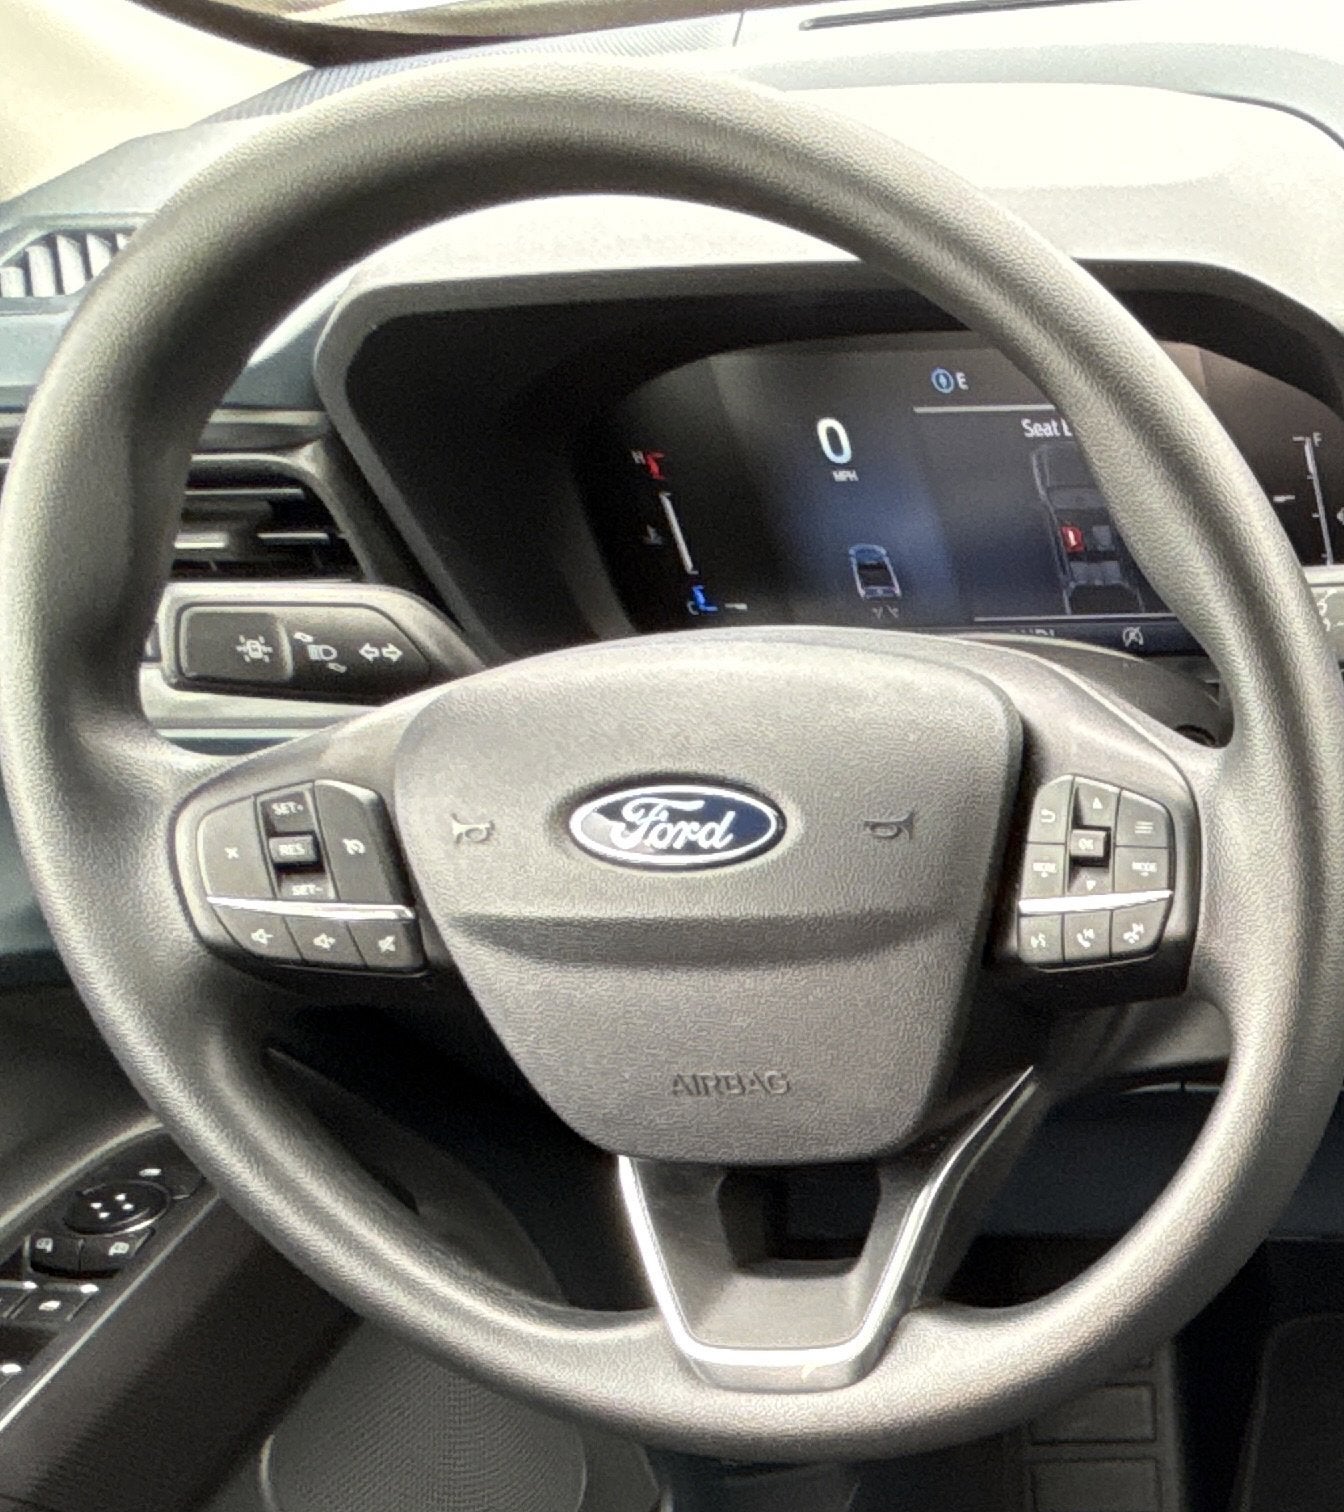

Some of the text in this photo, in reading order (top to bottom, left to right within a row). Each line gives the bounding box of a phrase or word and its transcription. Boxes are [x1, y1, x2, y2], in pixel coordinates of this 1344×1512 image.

[956, 371, 969, 391] E
[816, 417, 852, 464] 0
[1021, 418, 1060, 437] Seat
[609, 797, 735, 850] Ford
[672, 1070, 791, 1097] AIRBAG
